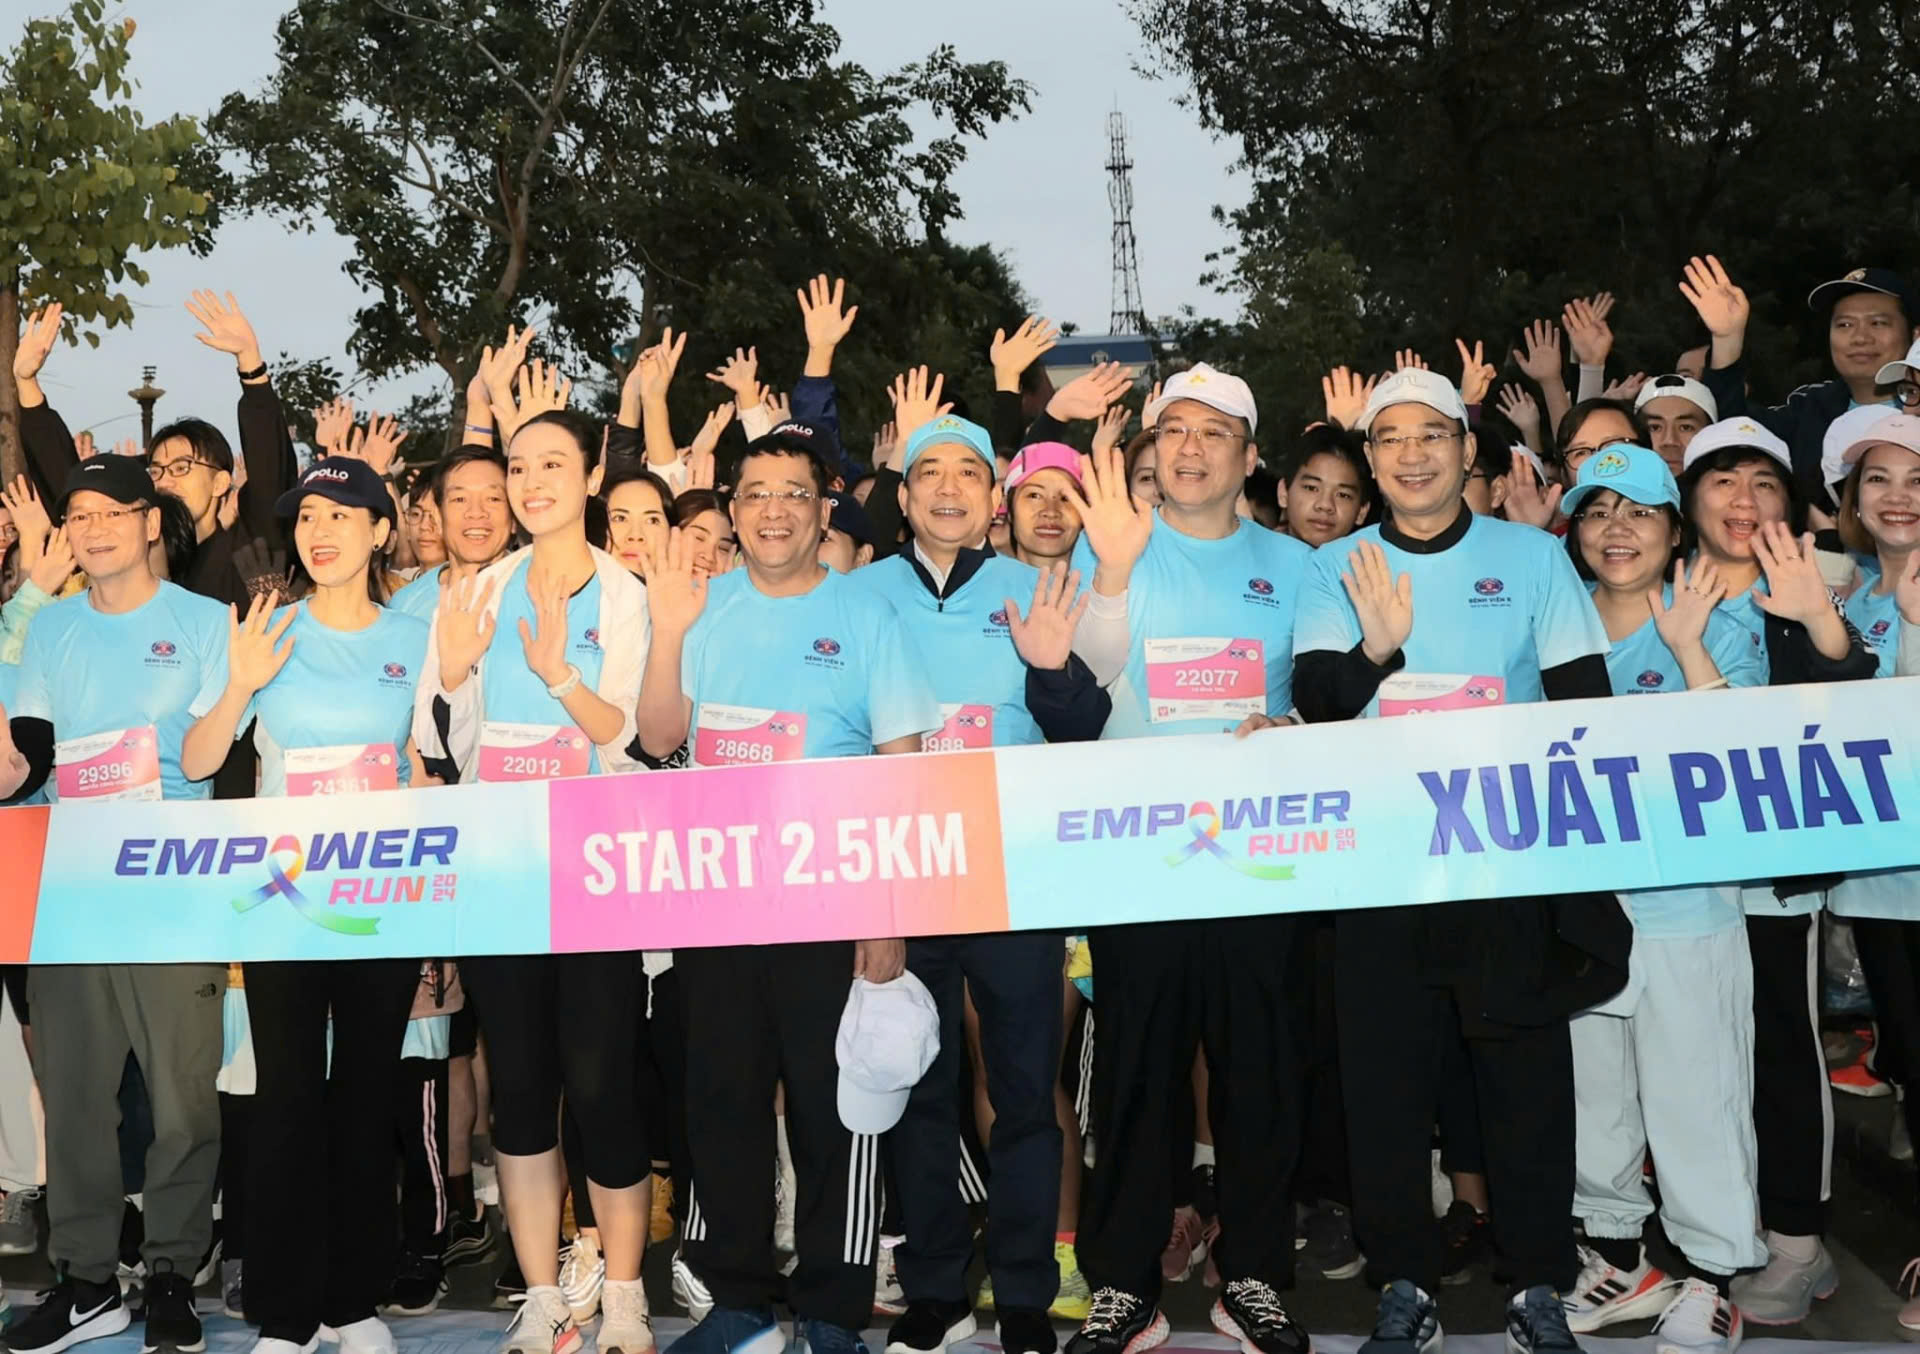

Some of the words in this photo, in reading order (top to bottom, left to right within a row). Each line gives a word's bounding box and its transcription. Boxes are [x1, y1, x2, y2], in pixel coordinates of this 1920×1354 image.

[1175, 669, 1239, 688] 22077
[715, 739, 773, 763] 28668
[78, 761, 134, 785] 29396
[503, 755, 561, 777] 22012
[1417, 727, 1641, 855] XUẤT
[1669, 724, 1900, 837] PHÁT
[1057, 790, 1351, 842] EMPOWER
[115, 826, 458, 876] EMPOWER
[583, 825, 758, 895] START
[780, 812, 968, 884] 2.5KM
[1248, 829, 1329, 857] RUN
[328, 875, 425, 905] RUN
